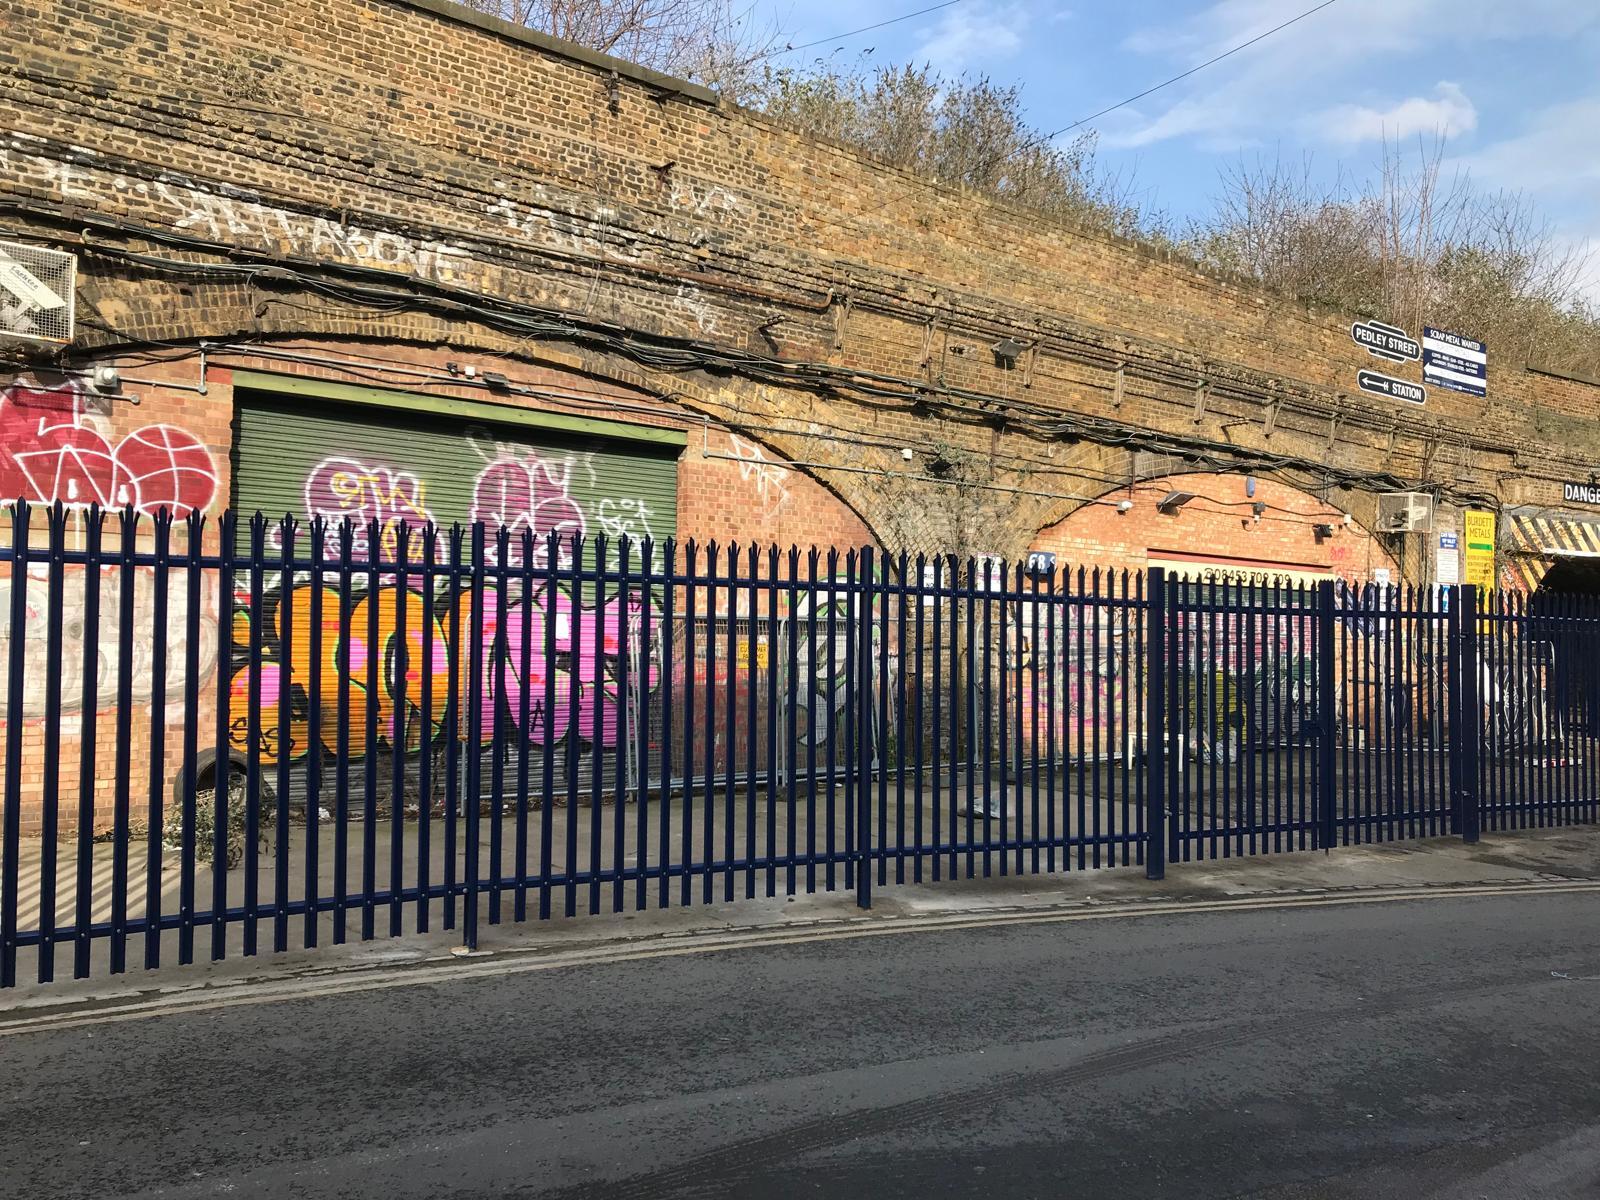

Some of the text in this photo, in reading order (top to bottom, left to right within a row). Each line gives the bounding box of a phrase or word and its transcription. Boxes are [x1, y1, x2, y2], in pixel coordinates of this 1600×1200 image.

[1356, 327, 1417, 356] PEDLEY STREET
[1430, 329, 1481, 351] SCRAP METAL WANTED
[1392, 382, 1422, 400] STATION
[1467, 516, 1492, 528] BURDETT
[1469, 528, 1491, 538] METALS
